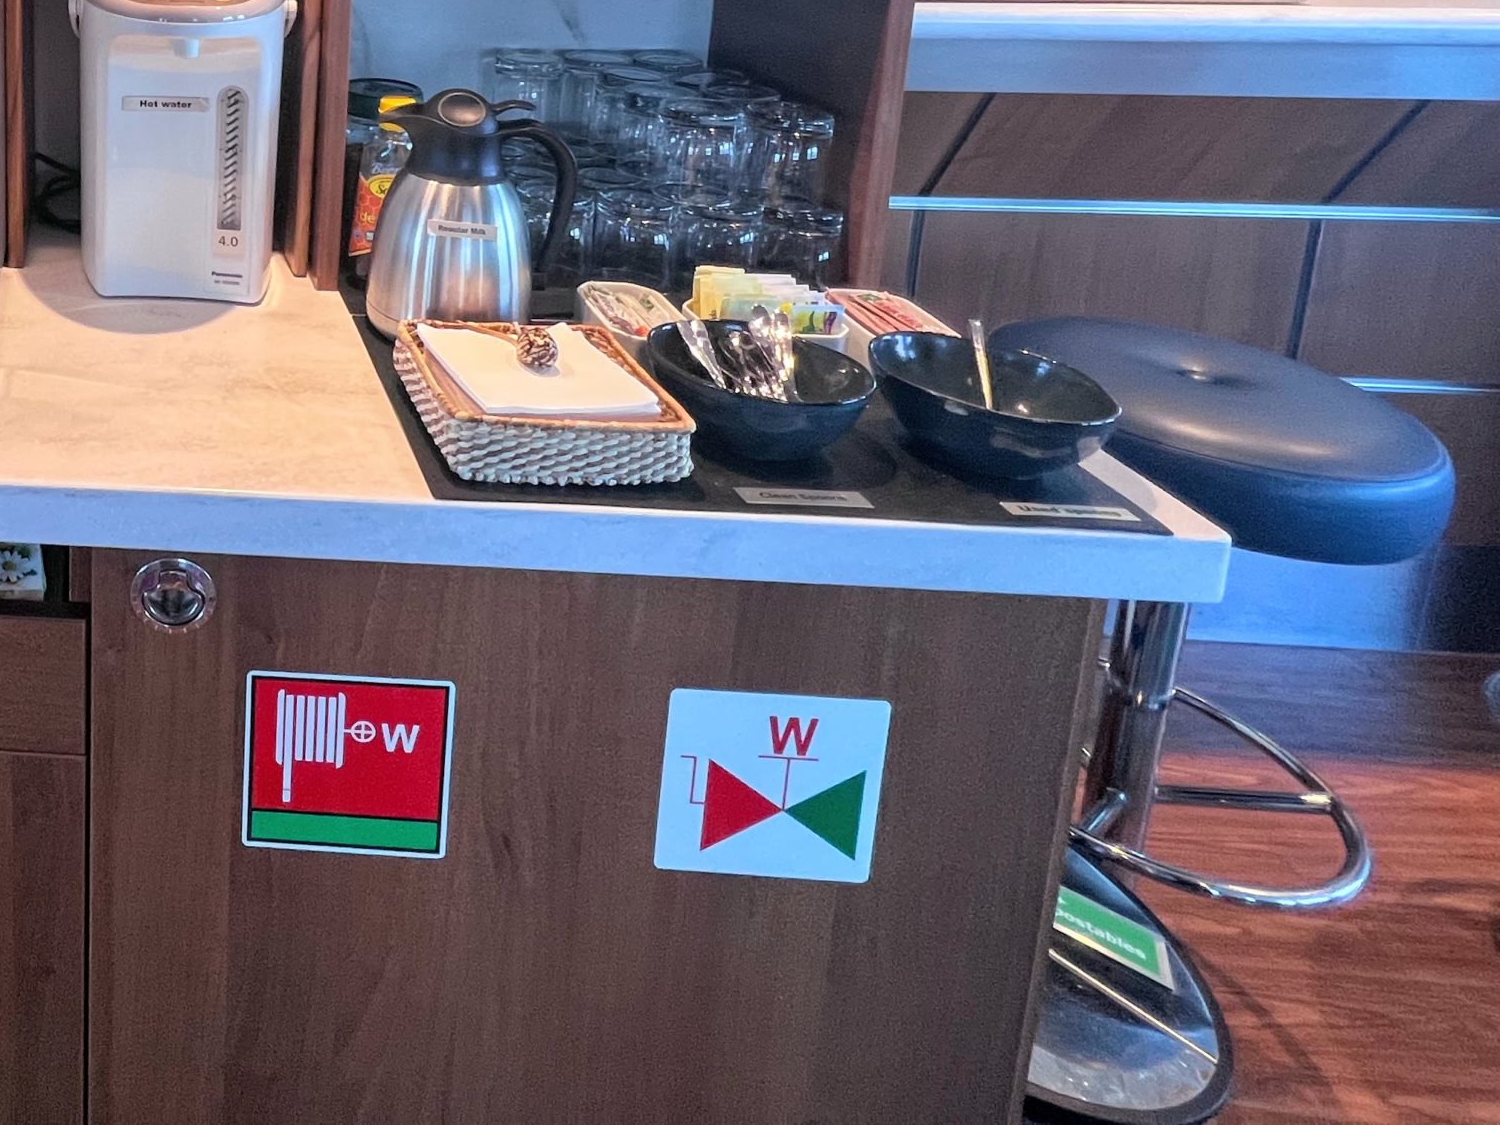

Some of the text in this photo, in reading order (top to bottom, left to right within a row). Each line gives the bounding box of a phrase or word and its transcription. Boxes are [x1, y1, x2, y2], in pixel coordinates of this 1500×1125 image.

[140, 100, 192, 109] Hot water
[218, 235, 239, 247] 4.0
[381, 723, 420, 754] W
[769, 715, 819, 756] W
